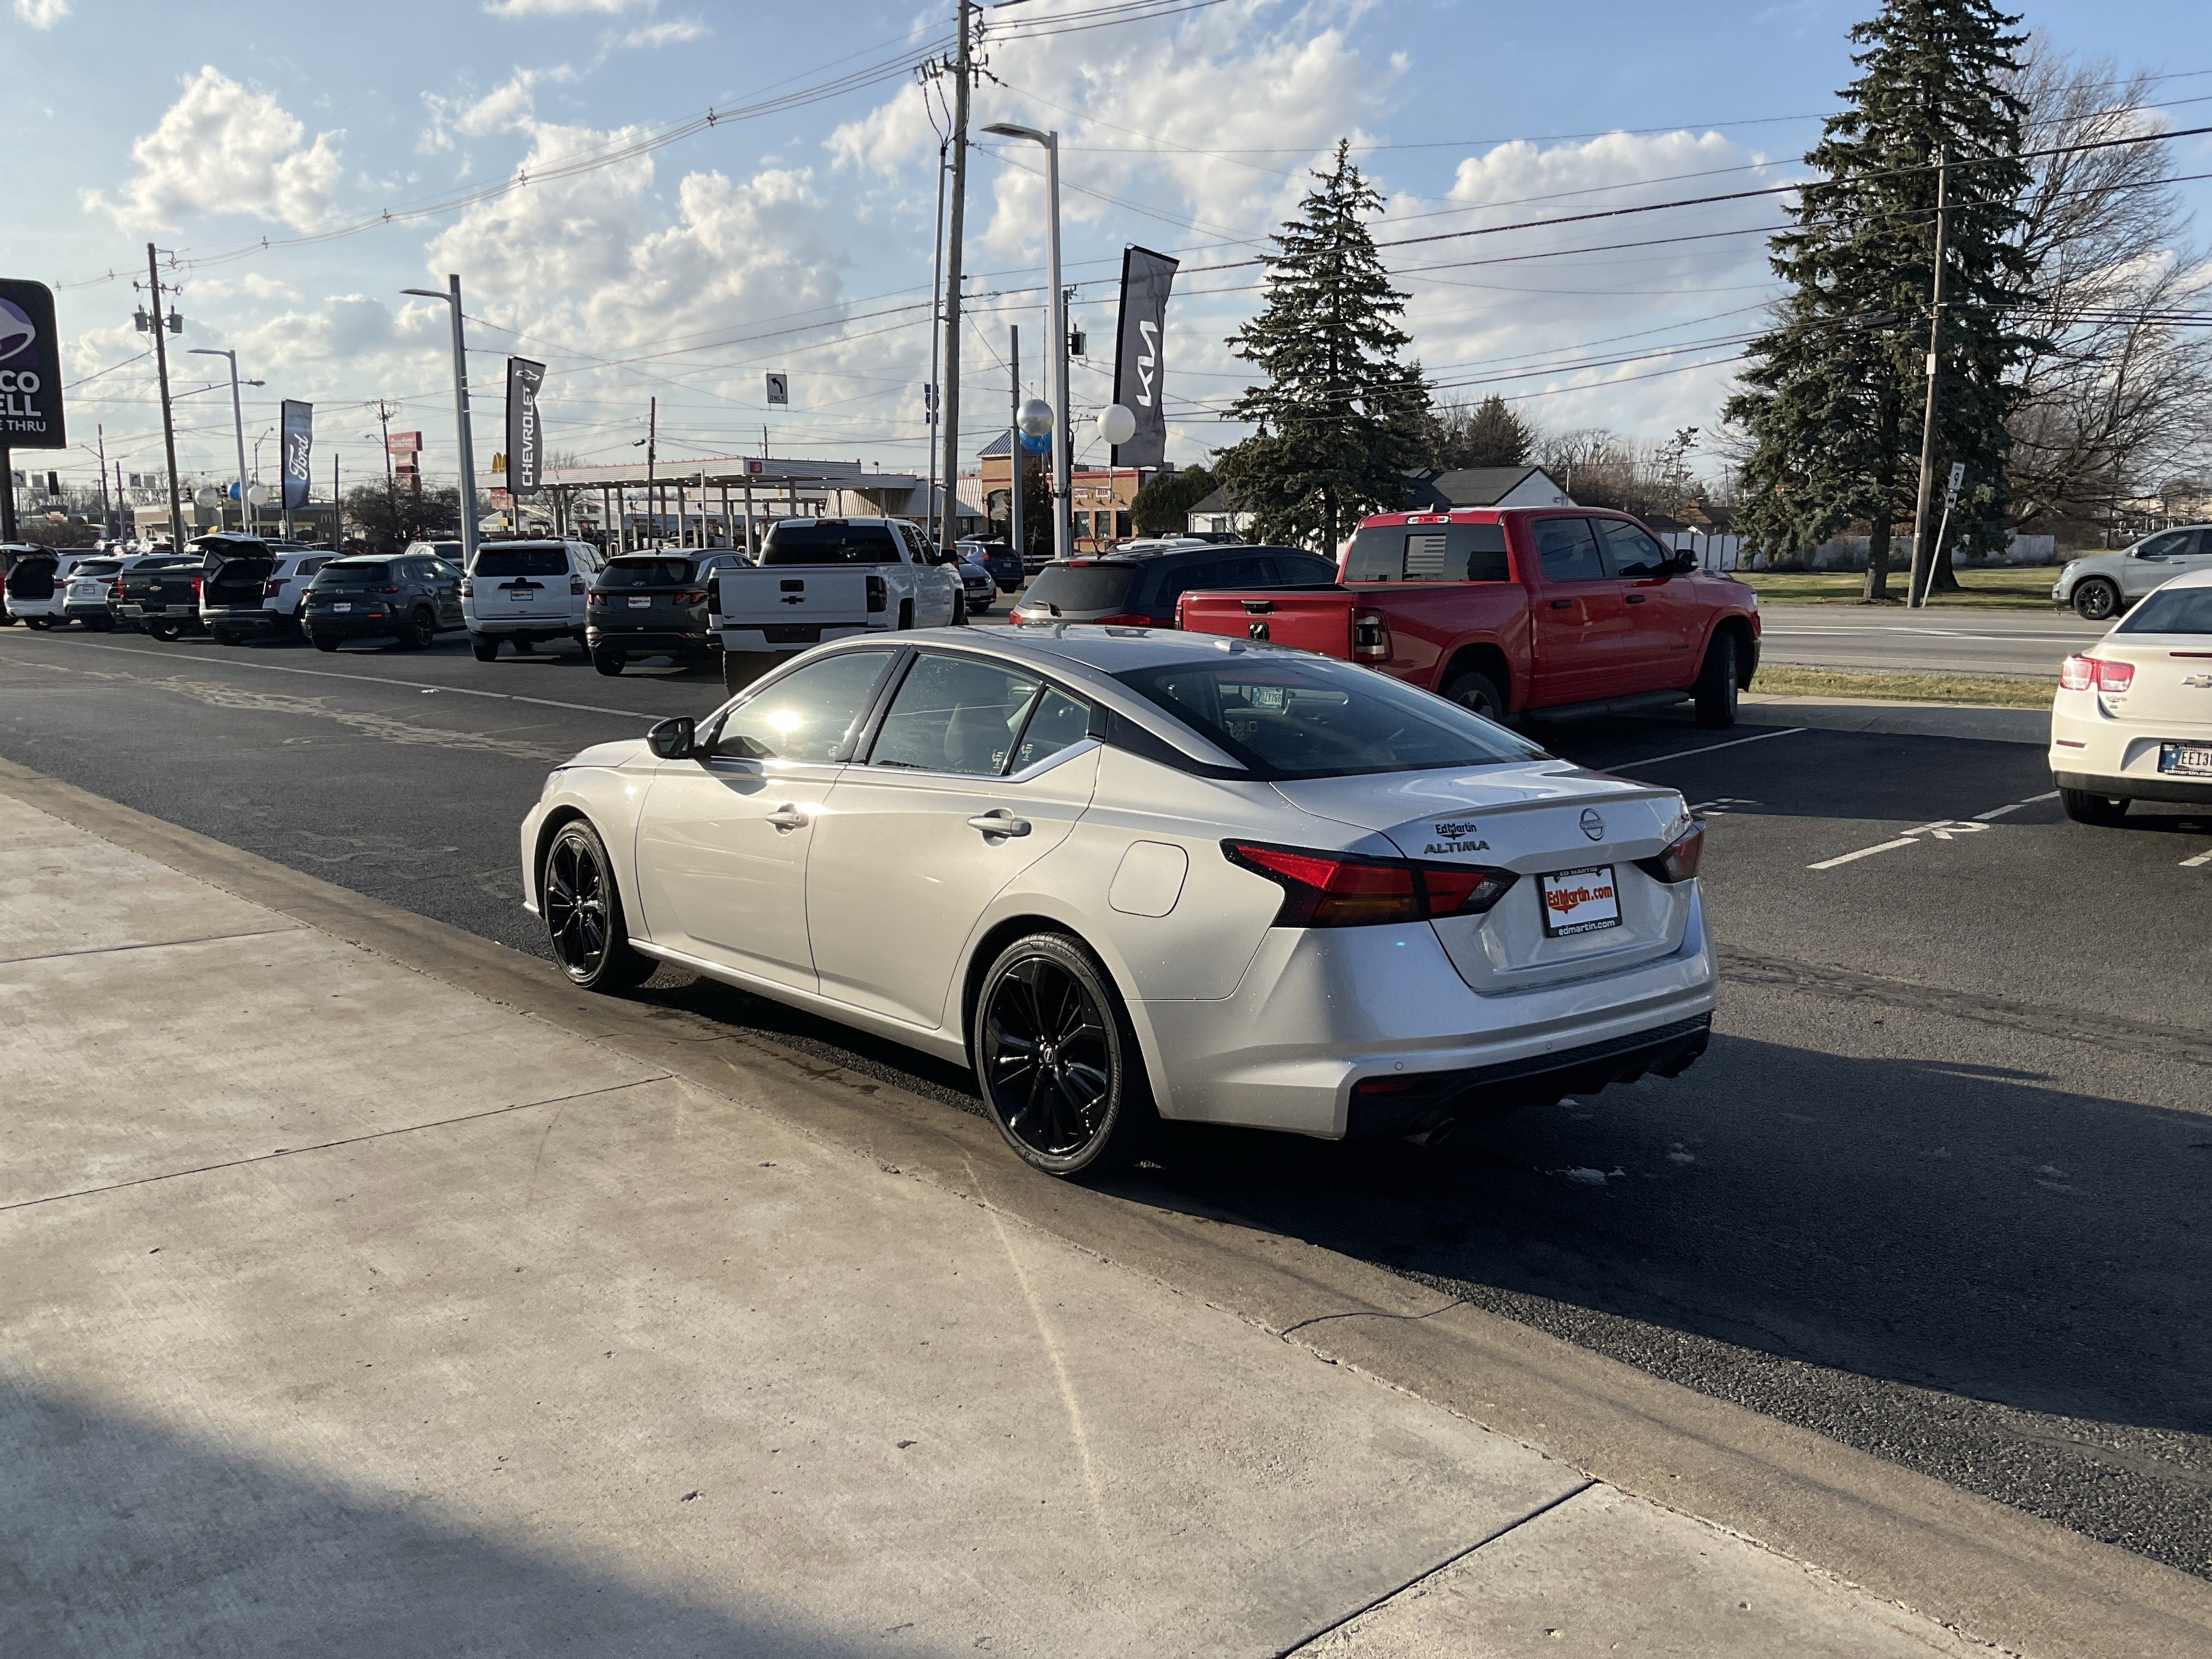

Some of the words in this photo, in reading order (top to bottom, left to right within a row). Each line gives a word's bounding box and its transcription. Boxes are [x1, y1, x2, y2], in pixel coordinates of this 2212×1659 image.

[0, 370, 40, 393] CO
[5, 419, 47, 432] THRU
[522, 385, 534, 487] CHEVROLET
[289, 433, 309, 481] Ford
[1954, 472, 1960, 487] 9
[2181, 751, 2212, 766] EEI3
[1435, 822, 1477, 834] EdMartin
[1424, 840, 1490, 854] ALTIMA
[1571, 867, 1598, 875] MARTIN
[1545, 886, 1613, 907] EdMartin.com
[1559, 919, 1615, 935] edmartin.com
[1043, 943, 1077, 964] TURANZA
